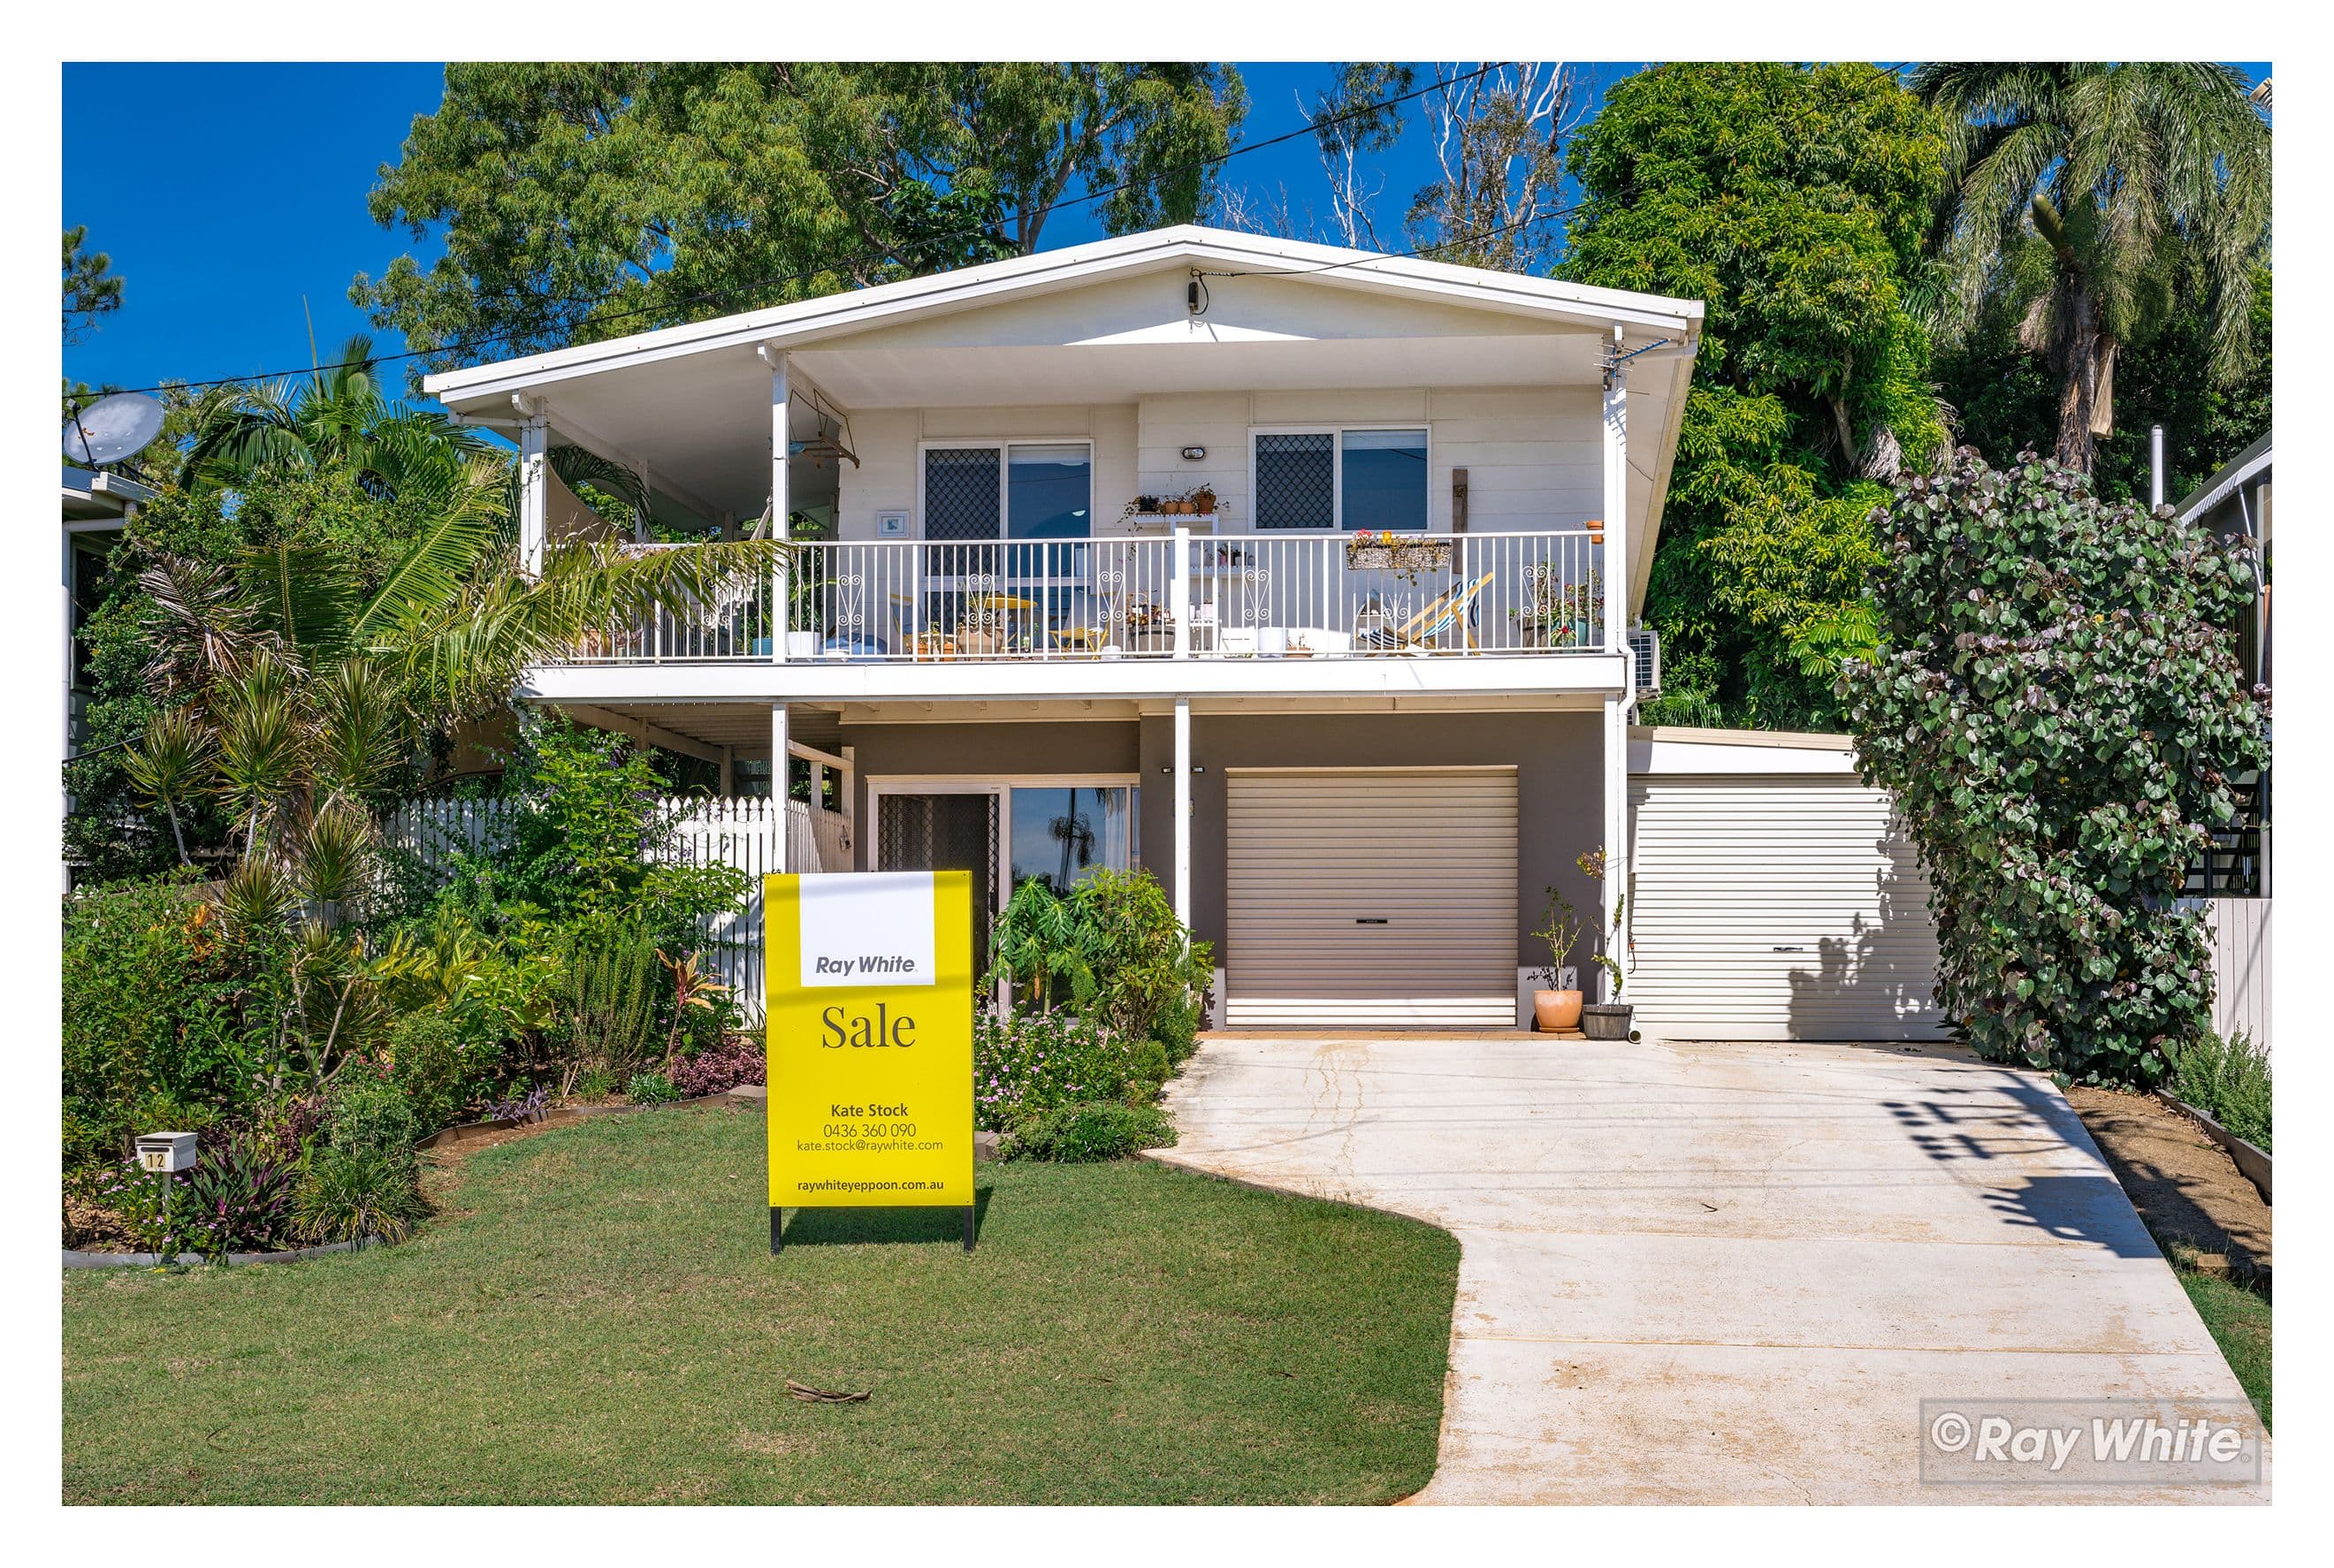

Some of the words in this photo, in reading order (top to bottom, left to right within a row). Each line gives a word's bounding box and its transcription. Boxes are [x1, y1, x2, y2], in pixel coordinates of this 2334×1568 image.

[816, 956, 855, 977] Ray
[858, 955, 915, 973] White
[822, 1002, 916, 1049] Sale
[831, 1104, 864, 1117] Kate
[868, 1103, 909, 1117] Stock
[823, 1123, 858, 1138] 0436
[861, 1123, 887, 1138] 360
[890, 1123, 917, 1138] 090
[797, 1138, 943, 1153] kate.stock@raywhite.com
[148, 1153, 164, 1168] 12
[797, 1179, 944, 1192] raywhiteyeppoon.com.au
